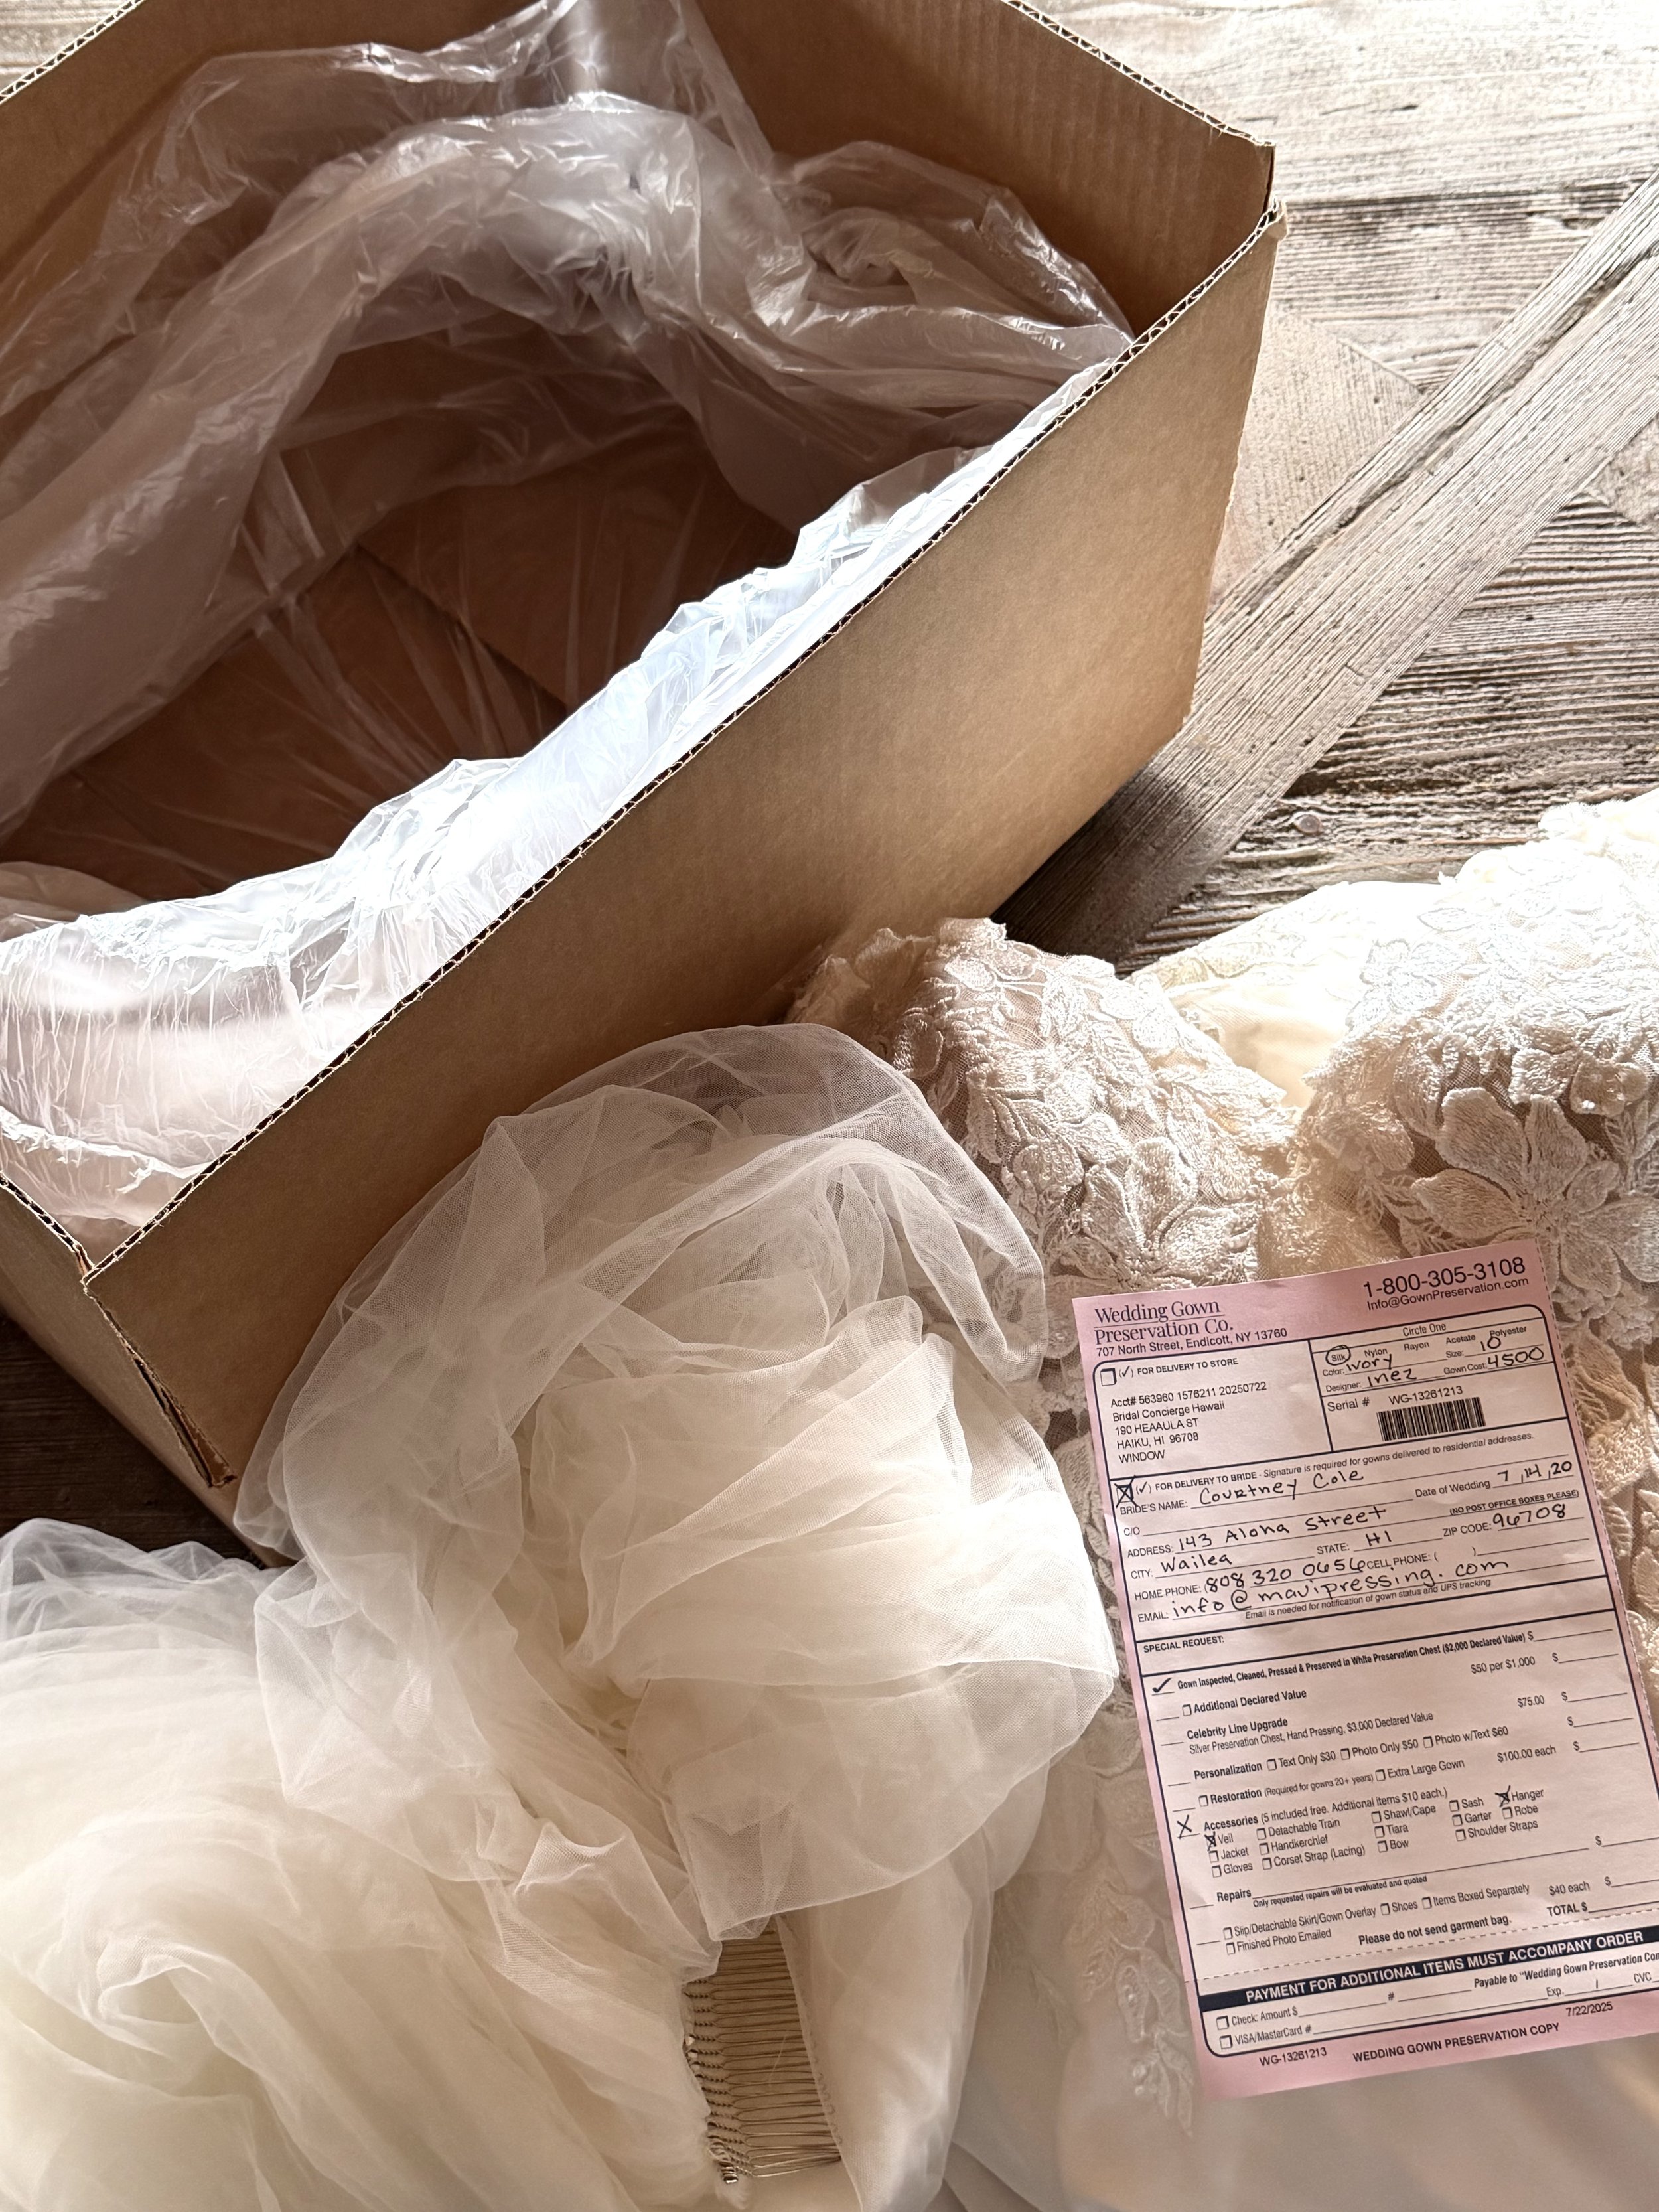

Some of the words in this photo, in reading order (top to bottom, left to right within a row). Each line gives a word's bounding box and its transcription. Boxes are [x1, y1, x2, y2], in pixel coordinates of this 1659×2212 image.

[1363, 1256, 1526, 1297] 1-800-305-3108
[1367, 1278, 1530, 1311] Info@GownPreservation.com
[1094, 1303, 1168, 1324] Wedding
[1171, 1301, 1221, 1317] Gown
[1095, 1321, 1200, 1345] Preservation
[1204, 1318, 1234, 1334] Co.
[1402, 1325, 1427, 1337] Circle
[1429, 1323, 1447, 1333] One
[1096, 1346, 1115, 1357] 707
[1118, 1343, 1147, 1355] North
[1149, 1340, 1183, 1352] Street,
[1185, 1335, 1233, 1349] Endicott,
[1235, 1331, 1251, 1343] NY
[1254, 1327, 1287, 1341] 13760
[1364, 1348, 1388, 1358] Nylon
[1404, 1342, 1429, 1351] Rayon
[1446, 1334, 1476, 1345] Acetate
[1489, 1326, 1527, 1338] Polyester
[1480, 1335, 1502, 1351] 10
[1137, 1366, 1154, 1375] FOR
[1155, 1363, 1195, 1374] DELIVERY
[1196, 1361, 1208, 1369] TO
[1210, 1357, 1239, 1368] STORE
[1488, 1347, 1544, 1368] 4500
[1443, 1366, 1467, 1375] Gown
[1467, 1363, 1488, 1372] Cost:
[1111, 1396, 1137, 1408] Acct#
[1139, 1392, 1174, 1405] 563960
[1177, 1388, 1216, 1401] 1576211
[1218, 1381, 1267, 1396] 20250722
[1325, 1382, 1362, 1392] Designer:
[1327, 1398, 1359, 1412] Serial
[1388, 1385, 1463, 1405] WG-13261213
[1112, 1410, 1140, 1422] Bridal
[1141, 1406, 1190, 1418] Concierge
[1192, 1400, 1225, 1413] Hawaii
[1115, 1425, 1133, 1436] 190
[1134, 1419, 1185, 1434] HEAAULA
[1186, 1417, 1198, 1428] ST
[1117, 1437, 1151, 1450] HAIKU,
[1169, 1432, 1199, 1444] 96708
[1118, 1449, 1165, 1464] WINDOW
[1155, 1482, 1173, 1491] FOR
[1174, 1477, 1214, 1489] DELIVERY
[1216, 1475, 1229, 1484] TO
[1230, 1471, 1257, 1482] BRIDE
[1263, 1467, 1302, 1479] Signature
[1313, 1458, 1348, 1471] required
[1362, 1454, 1390, 1465] gowns
[1392, 1447, 1431, 1460] delivered
[1443, 1438, 1486, 1452] residential
[1488, 1433, 1534, 1445] addresses.
[1313, 1470, 1364, 1488] Cole
[1415, 1488, 1437, 1498] Date
[1438, 1485, 1448, 1495] of
[1449, 1481, 1491, 1493] Wedding
[1119, 1503, 1157, 1515] BRIDE'S
[1158, 1499, 1188, 1511] NAME:
[1492, 1503, 1565, 1528] 96708
[1123, 1526, 1141, 1536] C/O
[1179, 1533, 1212, 1551] 143
[1305, 1505, 1387, 1531] Street
[1442, 1526, 1458, 1537] ZIP
[1460, 1522, 1492, 1534] CODE:
[1127, 1544, 1174, 1558] ADDRESS:
[1317, 1542, 1350, 1555] STATE:
[1160, 1554, 1232, 1573] Wailea
[1366, 1558, 1392, 1570] CELL
[1393, 1553, 1431, 1566] PHONE:
[1130, 1568, 1153, 1580] CITY:
[1252, 1568, 1292, 1585] 320
[1134, 1589, 1163, 1601] HOME
[1165, 1584, 1202, 1597] PHONE:
[1137, 1611, 1169, 1623] EMAIL:
[1143, 1641, 1181, 1653] SPECIAL
[1182, 1635, 1224, 1648] REQUEST:
[1177, 1680, 1198, 1690] Gown
[1198, 1674, 1236, 1687] Inspected,
[1236, 1669, 1267, 1682] Cleaned,
[1267, 1664, 1298, 1677] Pressed
[1305, 1659, 1342, 1672] Preserved
[1350, 1655, 1372, 1666] White
[1372, 1649, 1419, 1662] Preservation
[1419, 1645, 1441, 1656] Chest
[1442, 1641, 1469, 1655] ($2,000
[1469, 1635, 1502, 1649] Declared
[1502, 1632, 1526, 1644] Value)
[1470, 1662, 1488, 1674] $50
[1488, 1662, 1503, 1674] per
[1194, 1698, 1238, 1714] Additional
[1240, 1692, 1281, 1707] Declared
[1281, 1690, 1307, 1700] Value
[1517, 1694, 1545, 1708] $75.00
[1187, 1726, 1226, 1740] Celebrity
[1228, 1724, 1248, 1734] Line
[1249, 1717, 1288, 1732] Upgrade
[1189, 1744, 1210, 1755] Silver
[1211, 1737, 1260, 1751] Preservation
[1496, 1748, 1533, 1763] $100.00
[1534, 1745, 1557, 1757] each
[1194, 1763, 1263, 1780] Personalization
[1210, 1789, 1262, 1804] Restoration
[1461, 1797, 1484, 1809] Sash
[1511, 1789, 1544, 1801] Hanger
[1383, 1805, 1437, 1820] Shawl/Cape
[1464, 1812, 1492, 1824] Garter
[1514, 1805, 1538, 1816] Robe
[1204, 1815, 1259, 1831] Accessories
[1267, 1821, 1317, 1837] Detachable
[1318, 1819, 1340, 1830] Train
[1385, 1824, 1409, 1834] Tiara
[1217, 1832, 1234, 1844] Veil
[1270, 1834, 1328, 1852] Handkerchief
[1389, 1839, 1409, 1850] Bow
[1221, 1846, 1250, 1860] Jacket
[1223, 1862, 1254, 1874] Gloves
[1216, 1889, 1252, 1902] Repairs
[1546, 1903, 1581, 1917] TOTAL
[1358, 1933, 1390, 1945] Please
[1449, 1917, 1489, 1933] garment
[1490, 1915, 1511, 1926] bag.
[1246, 1982, 1306, 2002] PAYMENT
[1309, 1977, 1337, 1992] FOR
[1340, 1965, 1421, 1988] ADDITIONAL
[1423, 1958, 1465, 1974] ITEMS
[1467, 1951, 1504, 1968] MUST
[1508, 1938, 1592, 1962] ACCOMPANY
[1596, 1931, 1644, 1949] ORDER
[1563, 1964, 1587, 1974] Gown
[1589, 1954, 1643, 1970] Preservation
[1234, 2025, 1303, 2045] VISA/MasterCard
[1259, 2047, 1327, 2067] WG-13261213
[1565, 2001, 1613, 2017] 7/22/2025
[1352, 2045, 1405, 2062] WEDDING
[1407, 2040, 1442, 2054] GOWN
[1444, 2027, 1528, 2049] PRESERVATION
[1530, 2022, 1559, 2035] COPY
